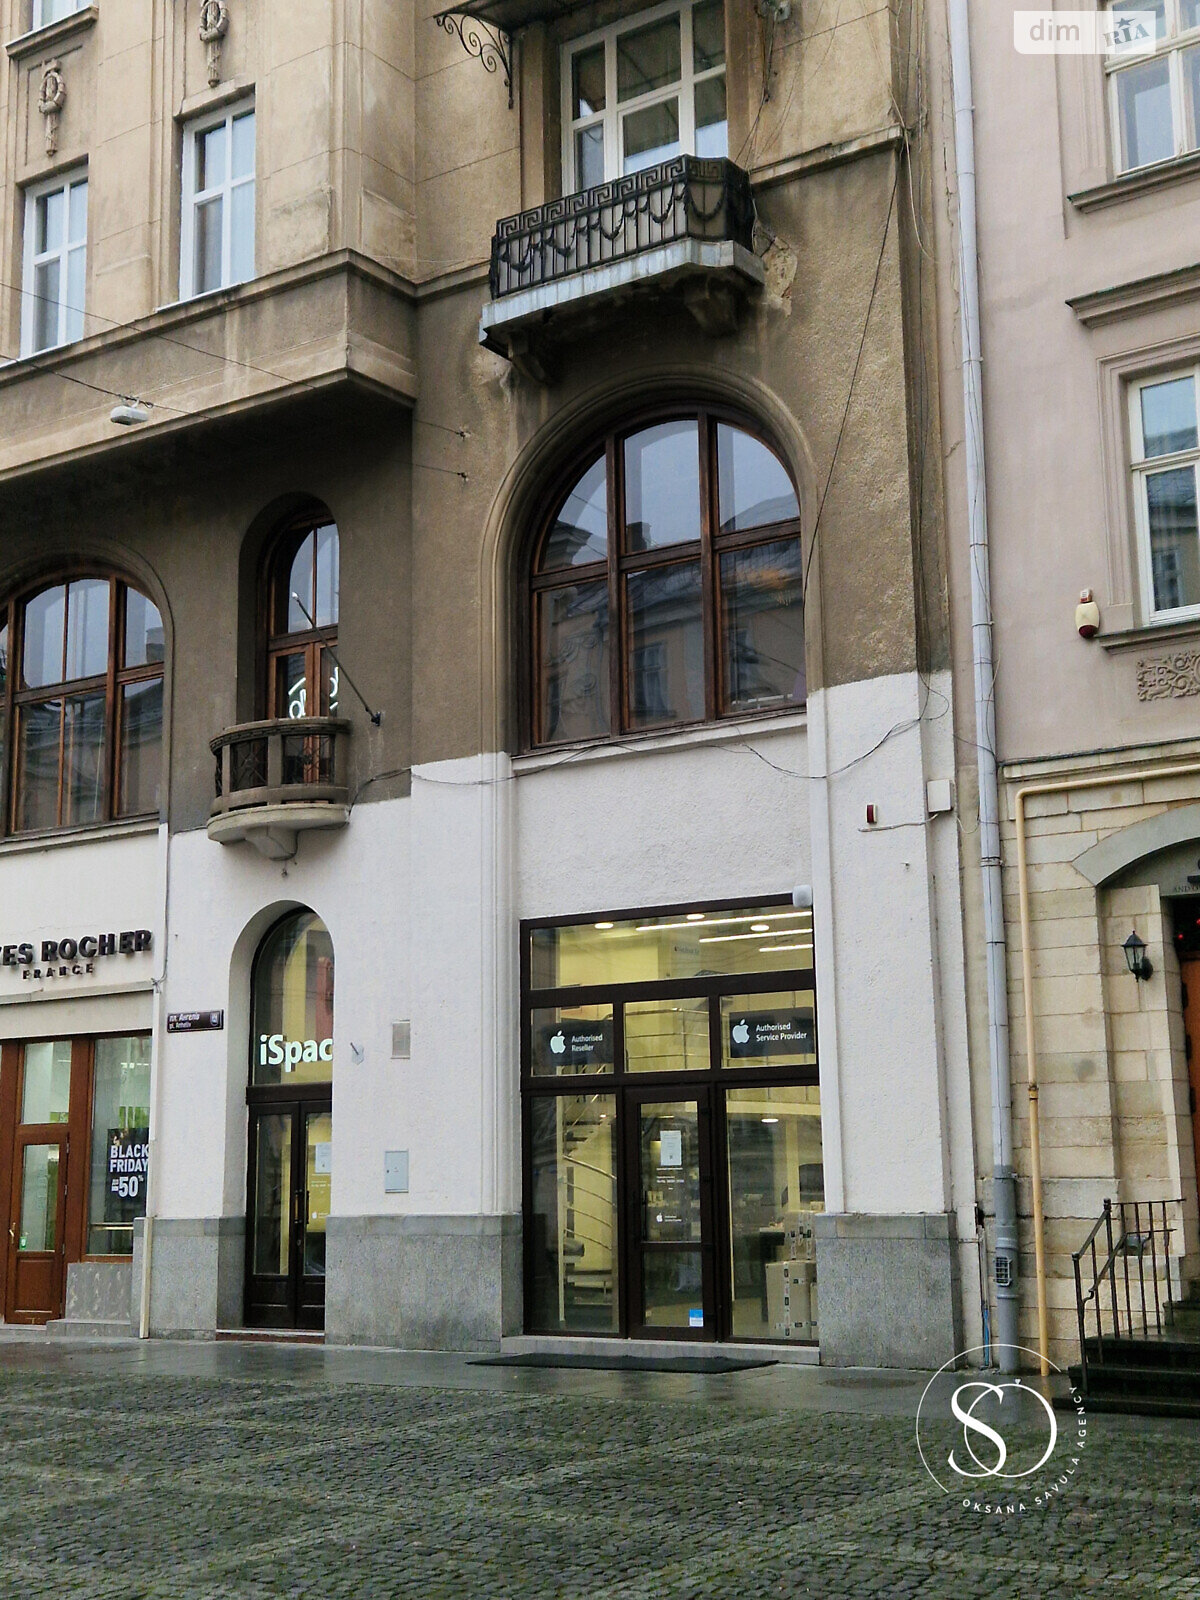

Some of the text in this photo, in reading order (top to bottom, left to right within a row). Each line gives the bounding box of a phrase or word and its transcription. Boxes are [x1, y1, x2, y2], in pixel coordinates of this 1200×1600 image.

[0, 929, 153, 966] ES ROCHER
[22, 963, 95, 980] FRANCE
[755, 1022, 791, 1032] Authorised
[571, 1033, 603, 1043] Authorised
[755, 1031, 807, 1042] Service Provider
[571, 1044, 594, 1052] Reseller
[110, 1144, 149, 1158] BLACK
[109, 1158, 149, 1173] FRIDAY
